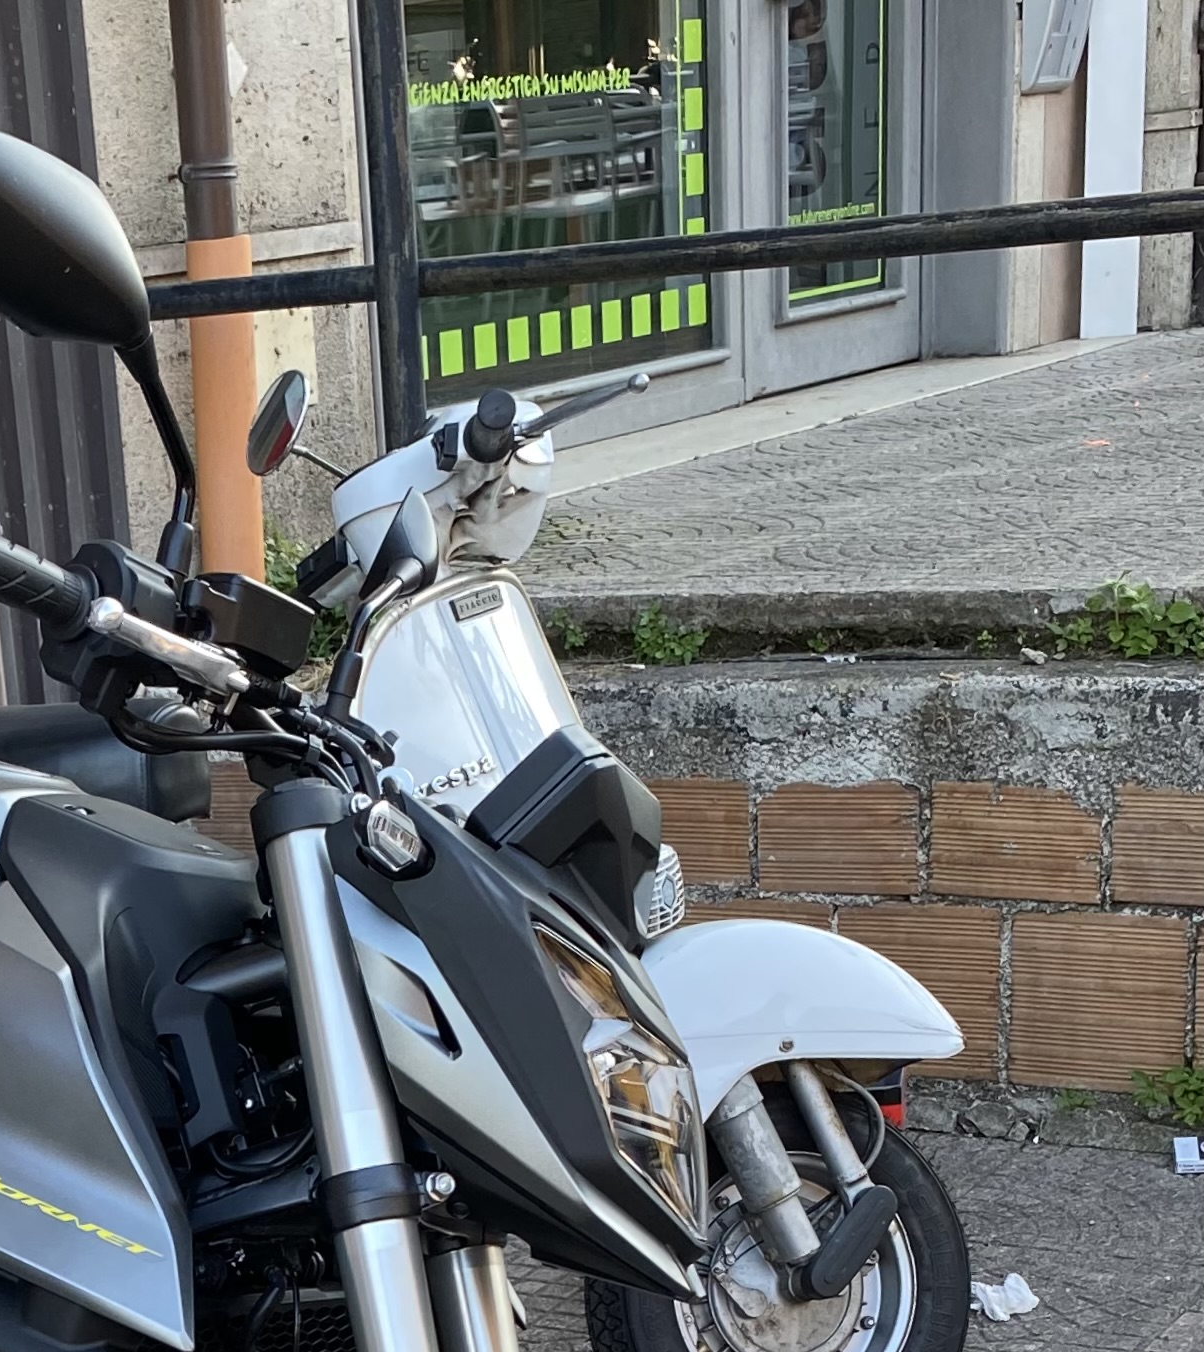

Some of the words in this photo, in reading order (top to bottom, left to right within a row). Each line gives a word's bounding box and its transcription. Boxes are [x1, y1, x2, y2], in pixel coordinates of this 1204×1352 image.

[462, 73, 541, 102] ENERGETICA
[544, 73, 559, 95] SU
[561, 69, 607, 95] MISURA
[608, 67, 631, 90] PER
